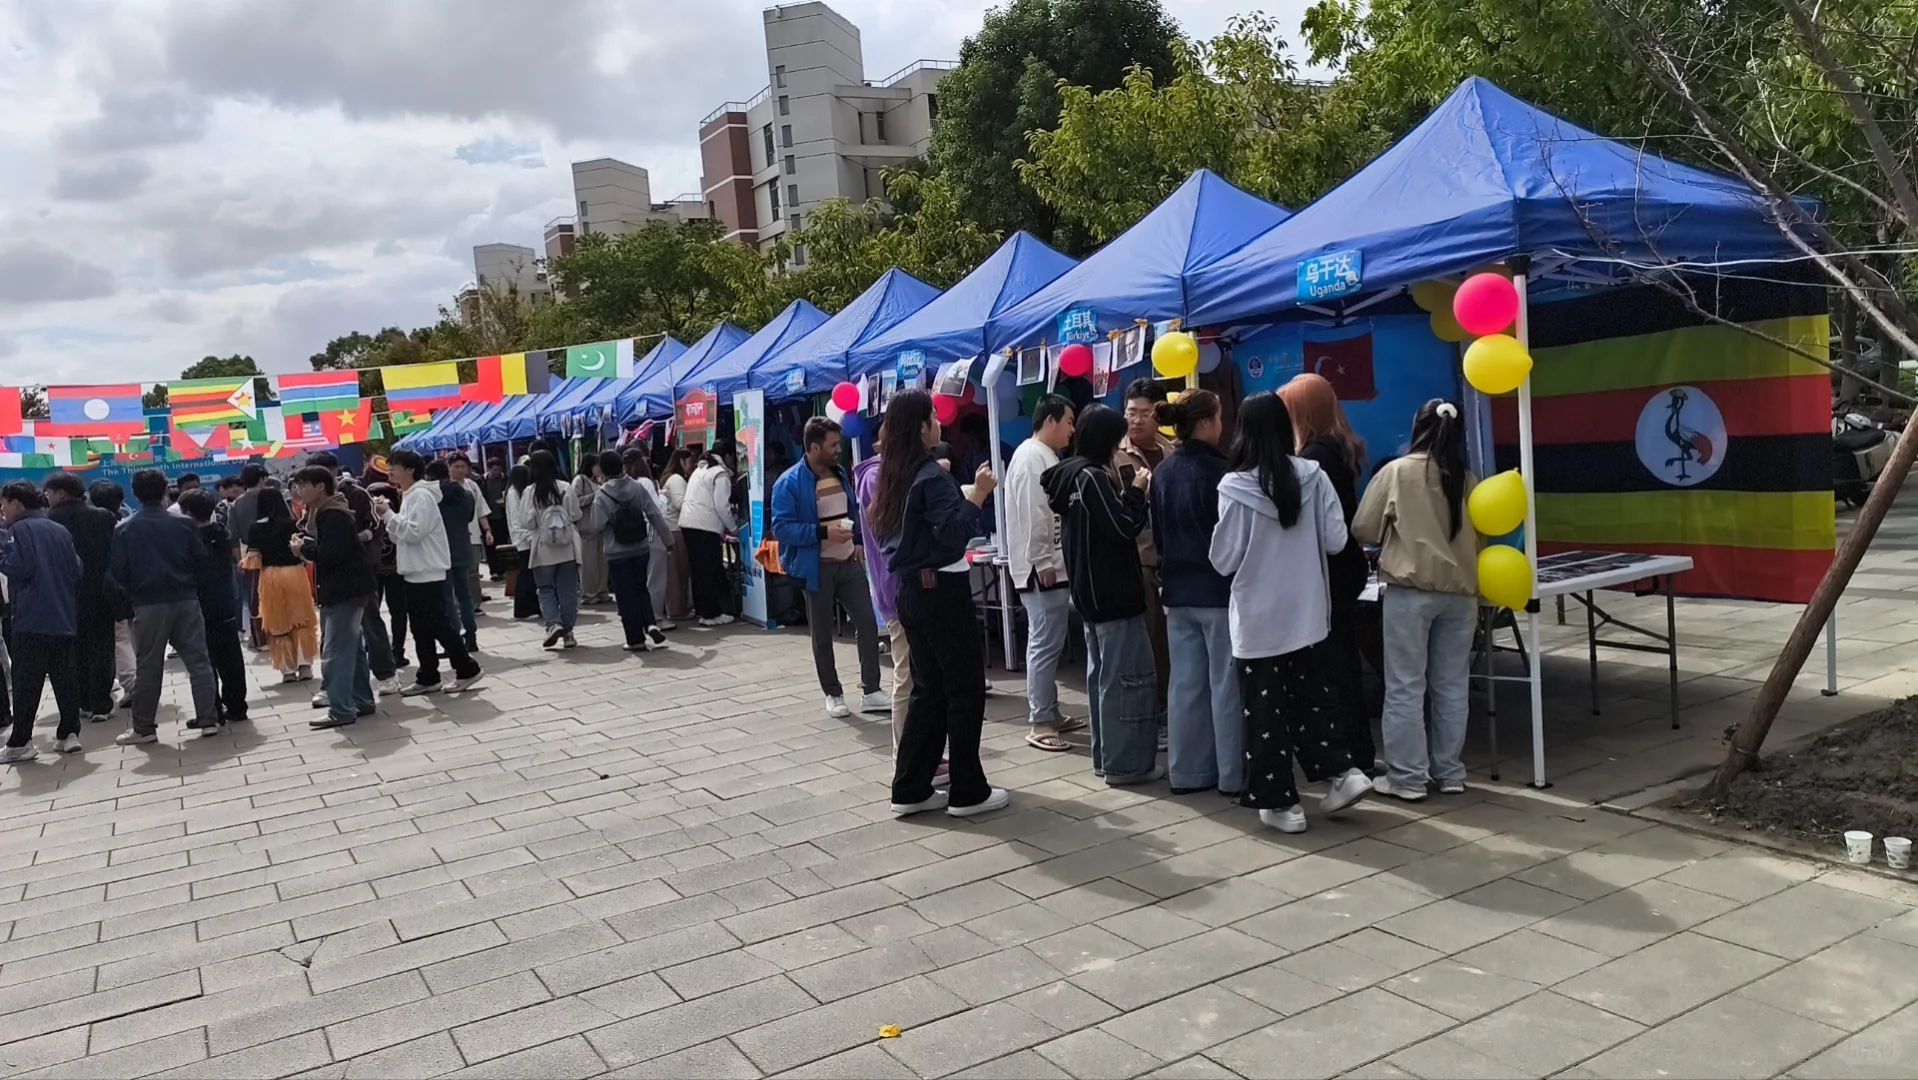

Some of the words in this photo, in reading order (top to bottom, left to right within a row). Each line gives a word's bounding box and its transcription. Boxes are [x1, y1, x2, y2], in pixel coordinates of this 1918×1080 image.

[1305, 255, 1351, 284] 乌干达
[1309, 279, 1346, 298] Uganda
[1063, 309, 1091, 332] 土耳其
[102, 468, 119, 476] The
